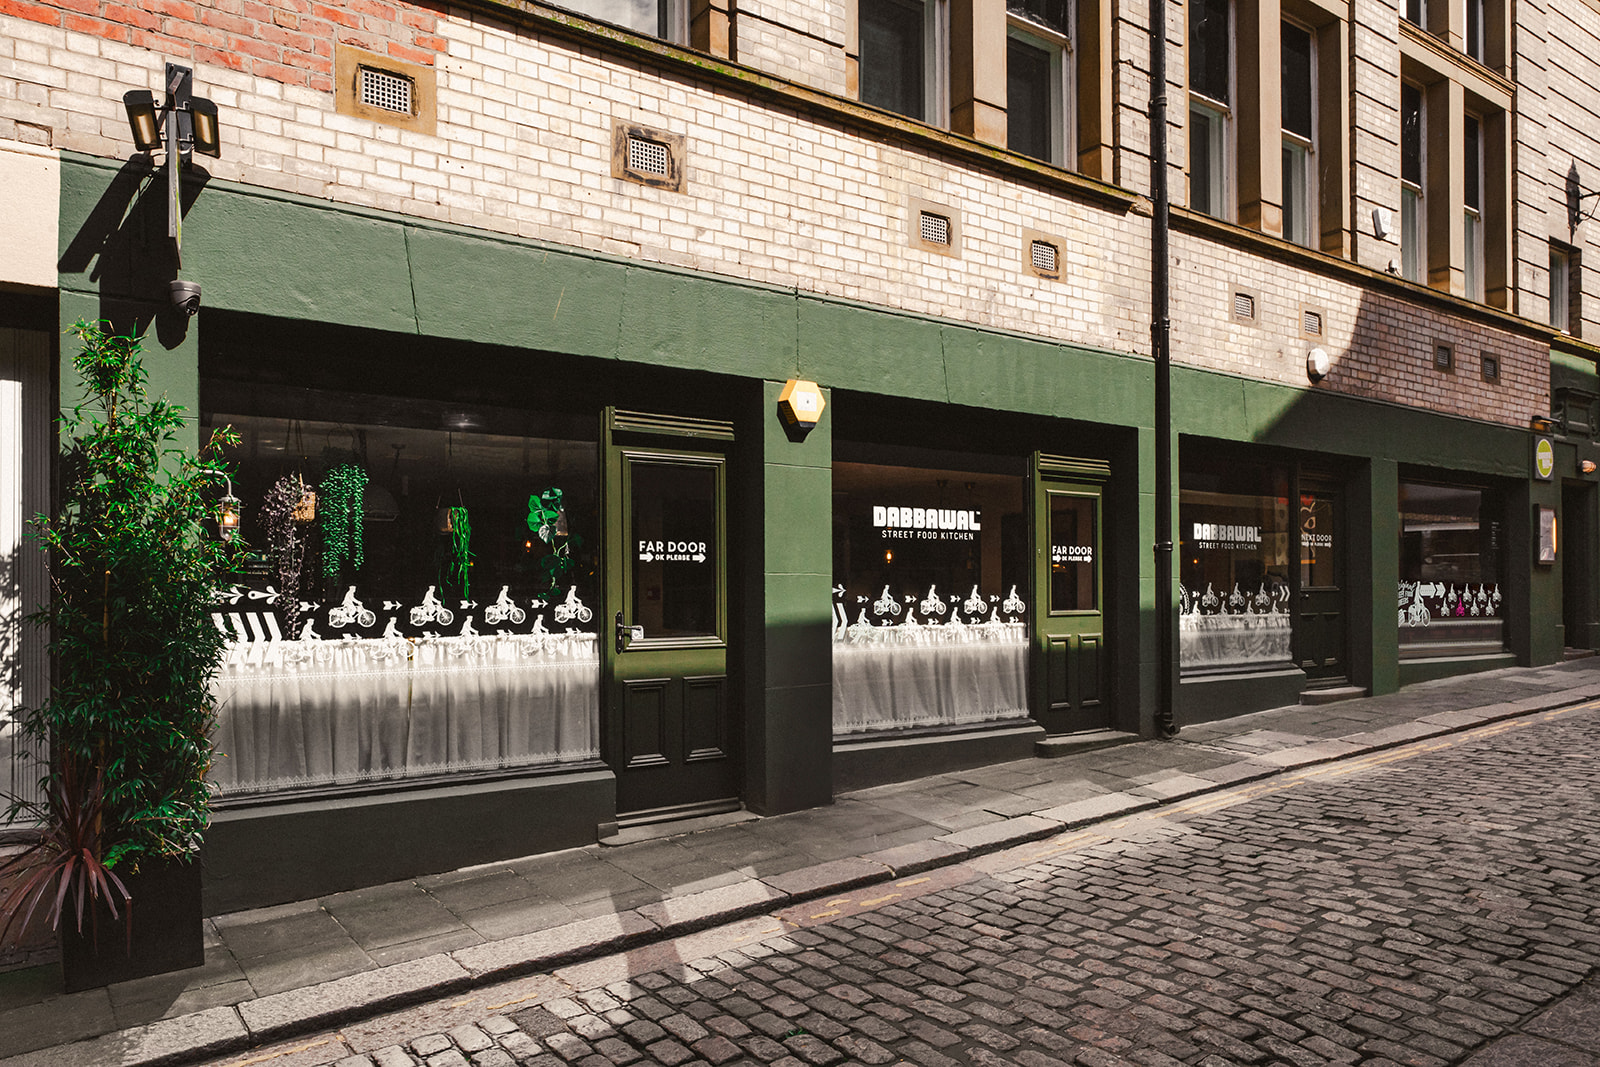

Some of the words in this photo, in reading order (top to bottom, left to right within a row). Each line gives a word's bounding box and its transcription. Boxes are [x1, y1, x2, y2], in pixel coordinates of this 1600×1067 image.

[873, 505, 981, 531] DABBAWAL
[881, 530, 914, 539] STREET
[917, 531, 938, 540] FOOD
[940, 532, 974, 541] KITCHEN
[1193, 523, 1262, 542] DABBAWAL
[639, 540, 664, 552] FAR
[667, 541, 706, 553] DOOR
[1052, 545, 1068, 555] FAR
[1069, 546, 1093, 555] DOOR
[1198, 541, 1219, 549] STREET
[655, 553, 665, 561] OK
